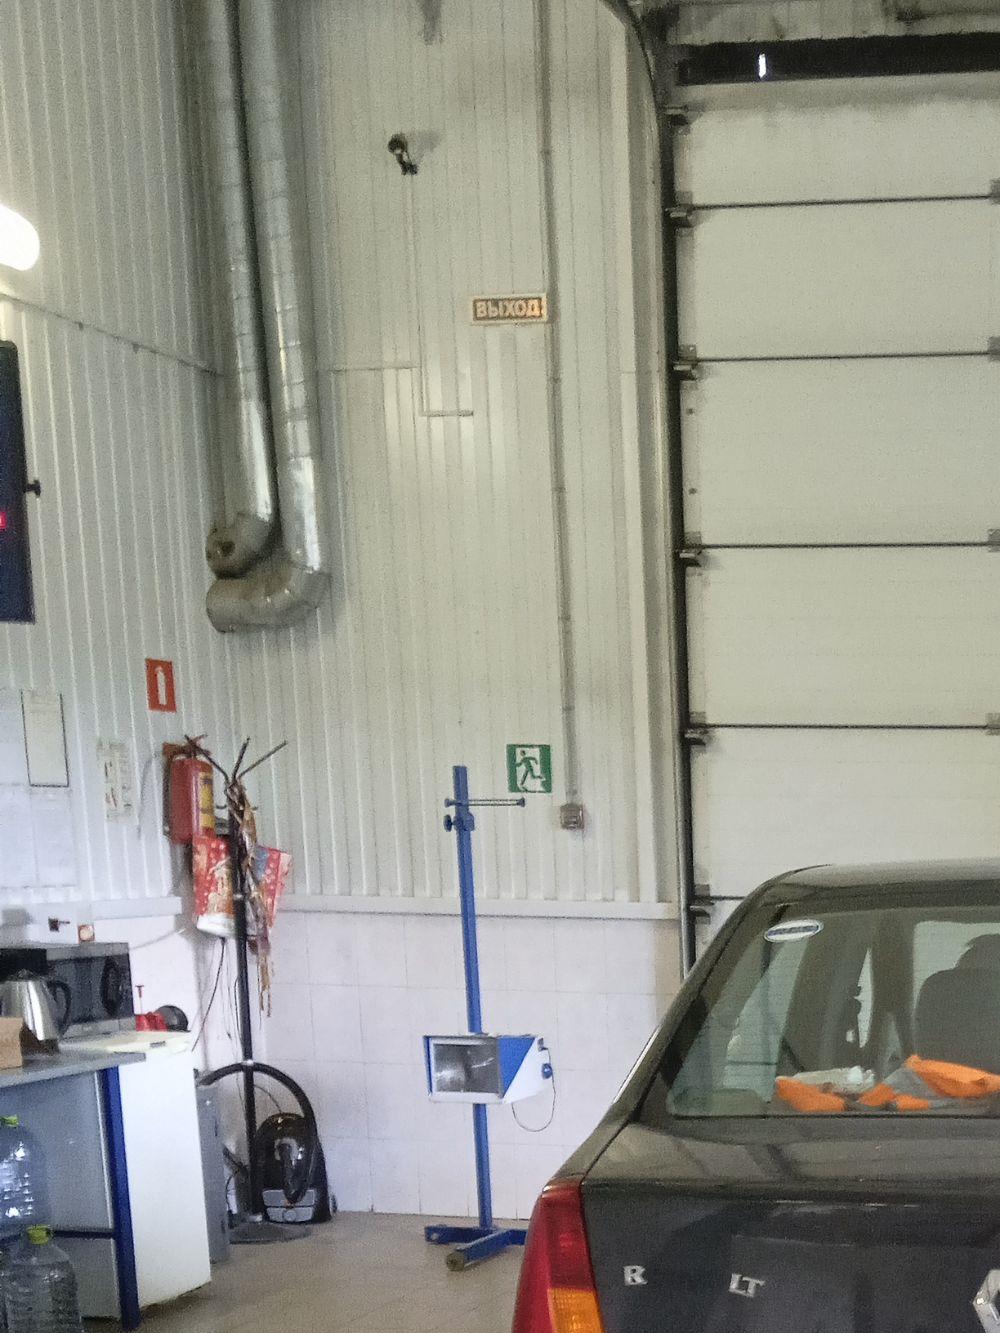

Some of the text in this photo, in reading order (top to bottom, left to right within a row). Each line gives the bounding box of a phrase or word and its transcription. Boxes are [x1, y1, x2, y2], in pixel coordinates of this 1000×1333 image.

[476, 299, 541, 319] ВЫХОД
[622, 1265, 766, 1298] R LT
